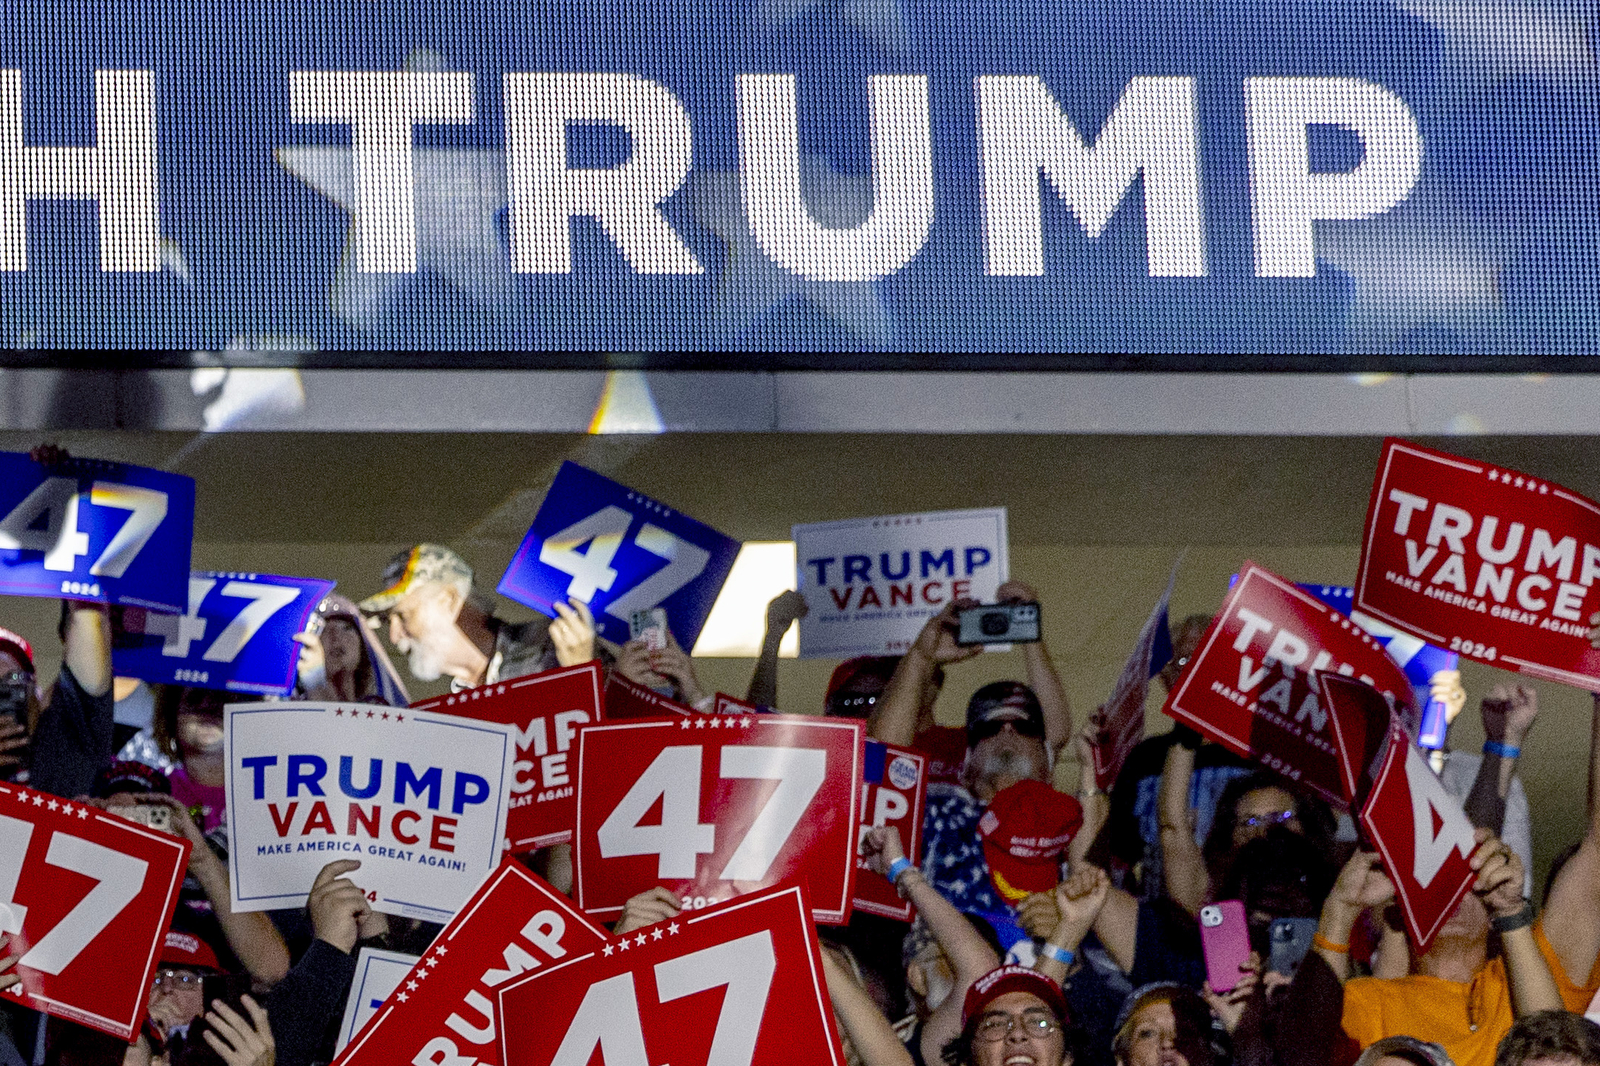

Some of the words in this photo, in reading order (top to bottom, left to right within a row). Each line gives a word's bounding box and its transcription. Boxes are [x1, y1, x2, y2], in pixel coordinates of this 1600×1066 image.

[288, 70, 1425, 283] TRUMP
[539, 503, 712, 621] 47
[807, 546, 992, 586] TRUMP
[1405, 539, 1588, 622] VANCE
[830, 579, 972, 611] VANCE
[1385, 570, 1421, 593] MAKE
[1423, 586, 1487, 614] AMERICA
[1490, 604, 1538, 626] GREAT
[1449, 636, 1498, 661] 2024
[1238, 655, 1328, 732] VAN
[242, 754, 490, 815] TRUMP
[509, 793, 533, 810] EAT
[268, 801, 458, 853] VANCE
[597, 744, 827, 880] 47
[257, 843, 293, 856] MAKE
[297, 841, 362, 854] AMERICA
[368, 845, 413, 862] GREAT
[418, 853, 466, 872] AGAIN!
[681, 896, 731, 911] 202
